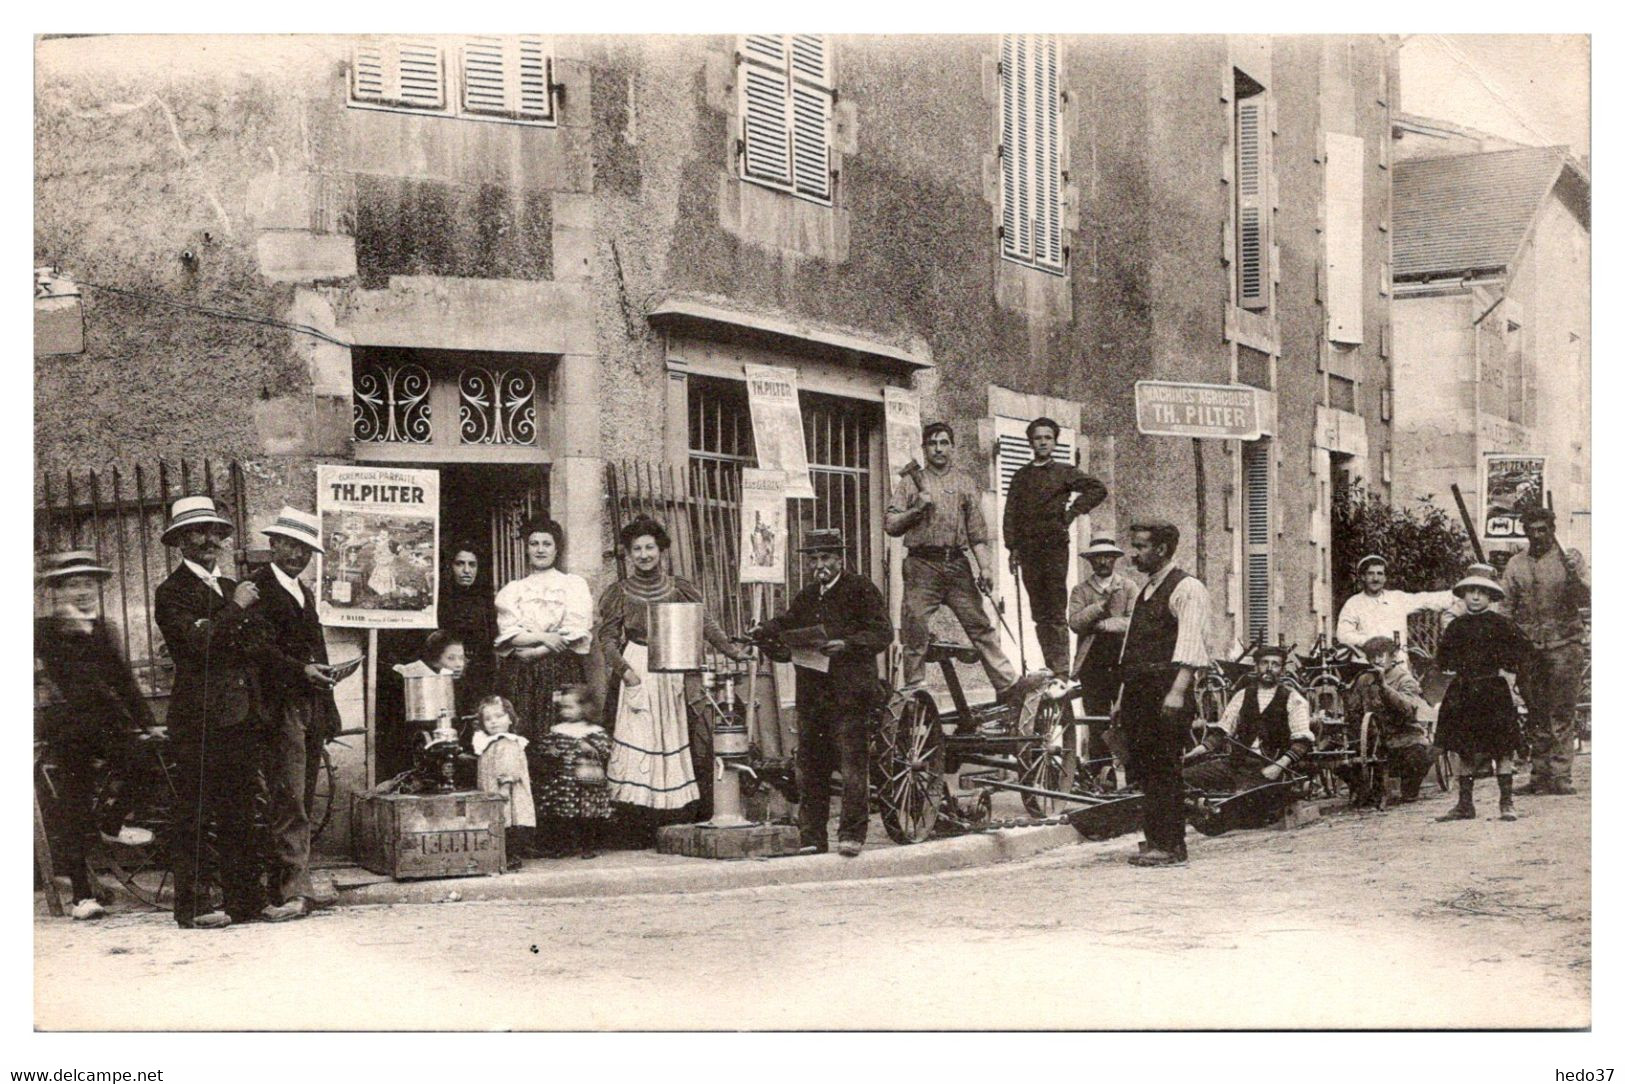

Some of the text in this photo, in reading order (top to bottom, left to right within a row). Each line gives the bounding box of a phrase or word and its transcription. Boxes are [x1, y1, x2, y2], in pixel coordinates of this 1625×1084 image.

[1142, 386, 1250, 407] MACHINES AGRICOLES
[1151, 403, 1246, 428] TH. PILTER
[379, 470, 416, 484] PARFAITE
